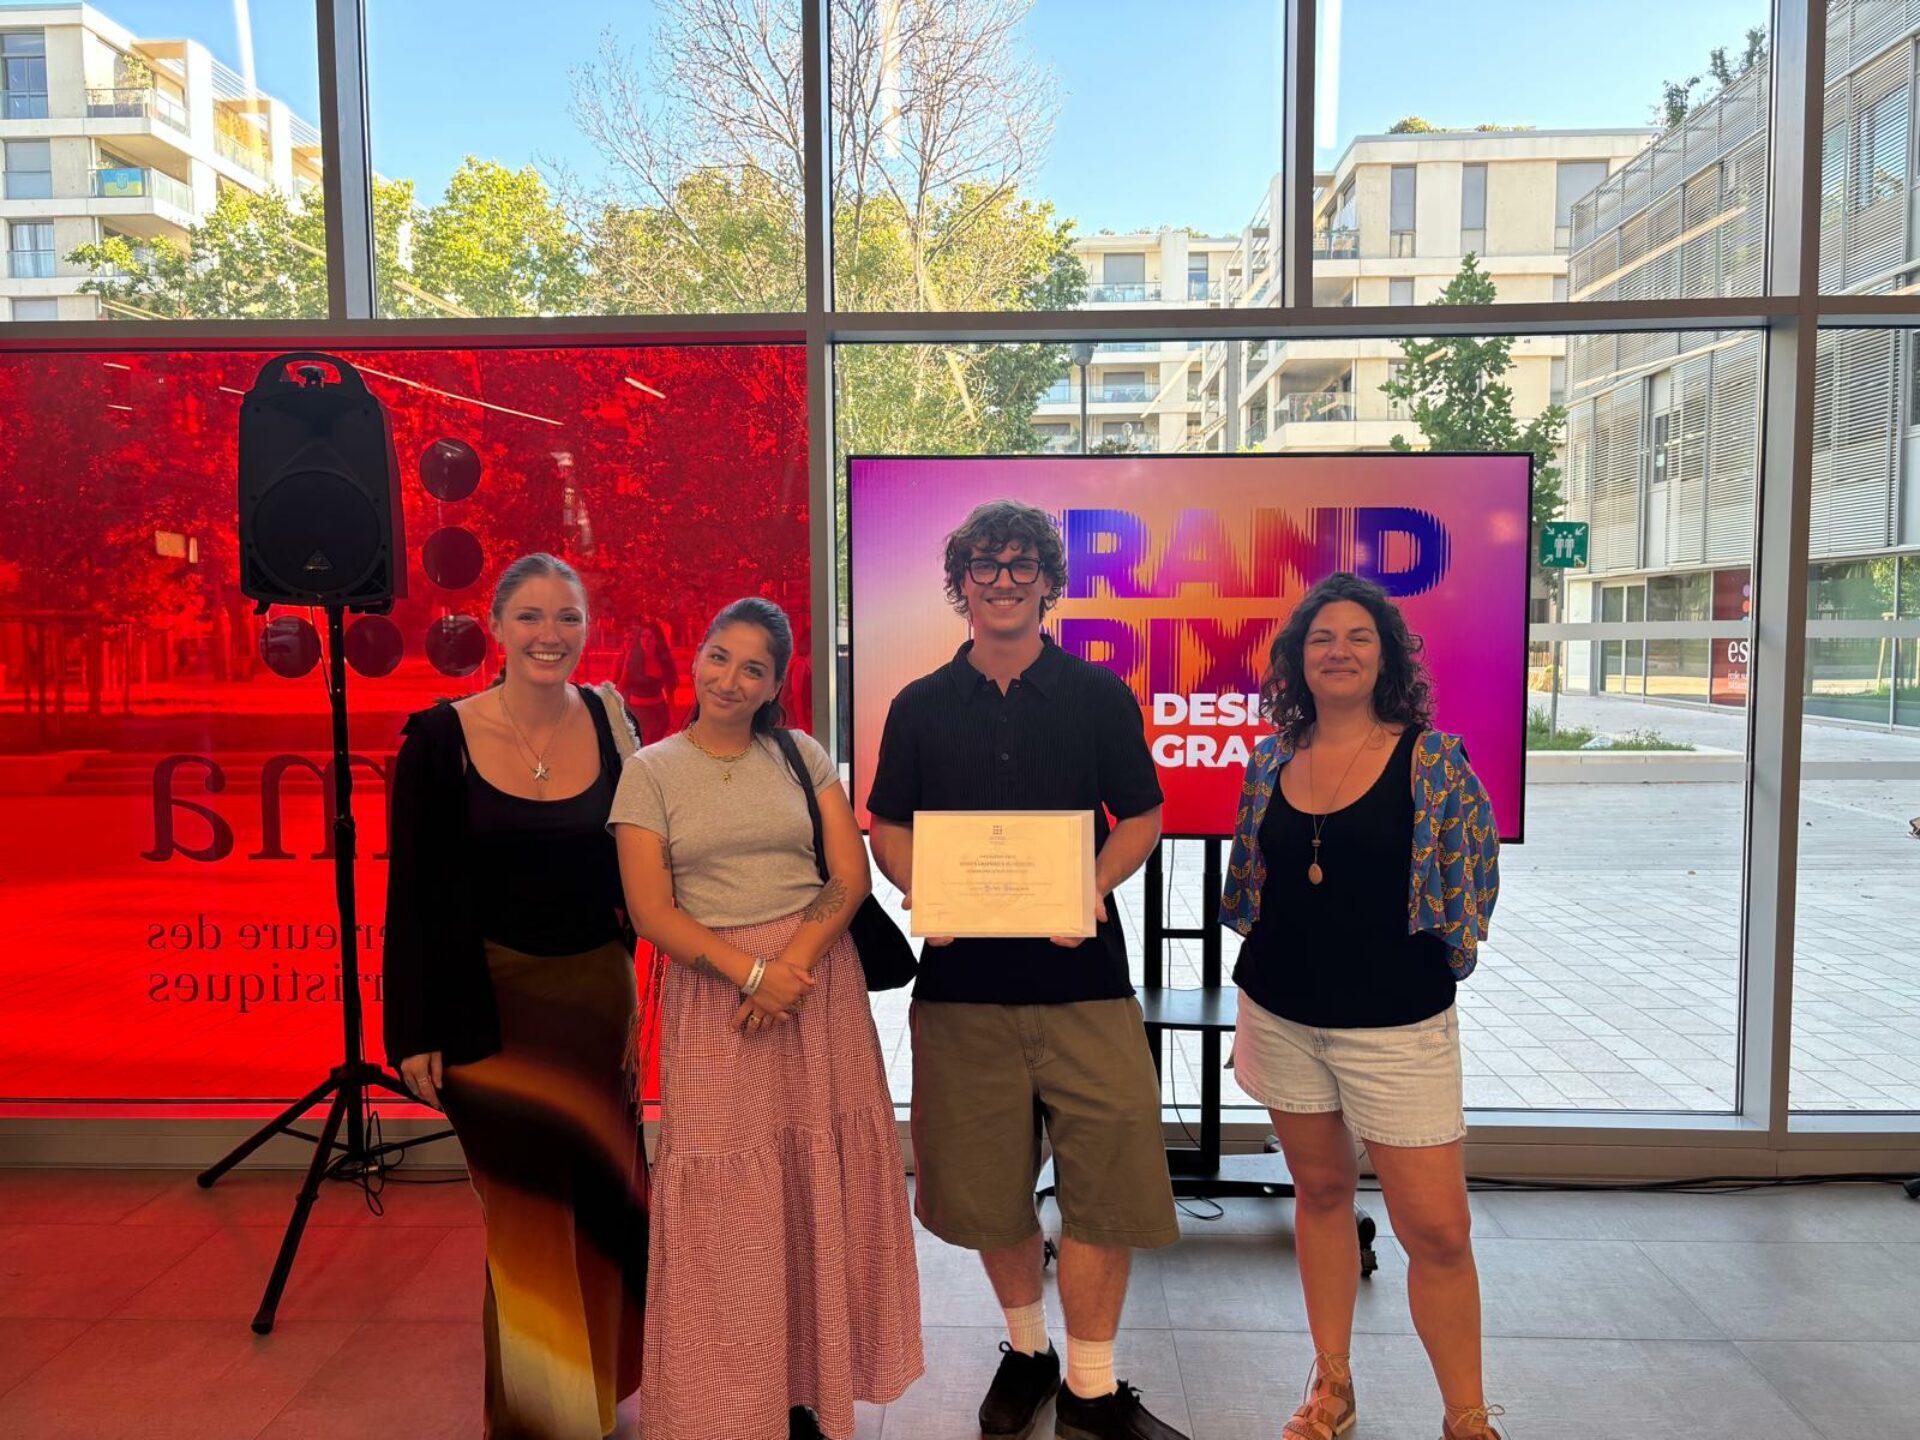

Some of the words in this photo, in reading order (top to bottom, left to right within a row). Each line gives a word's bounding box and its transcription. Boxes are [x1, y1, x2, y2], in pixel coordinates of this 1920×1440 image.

[1056, 507, 1452, 598] RAND
[1054, 618, 1279, 705] RIX
[1153, 693, 1303, 726] DESI
[1152, 734, 1275, 768] GRA
